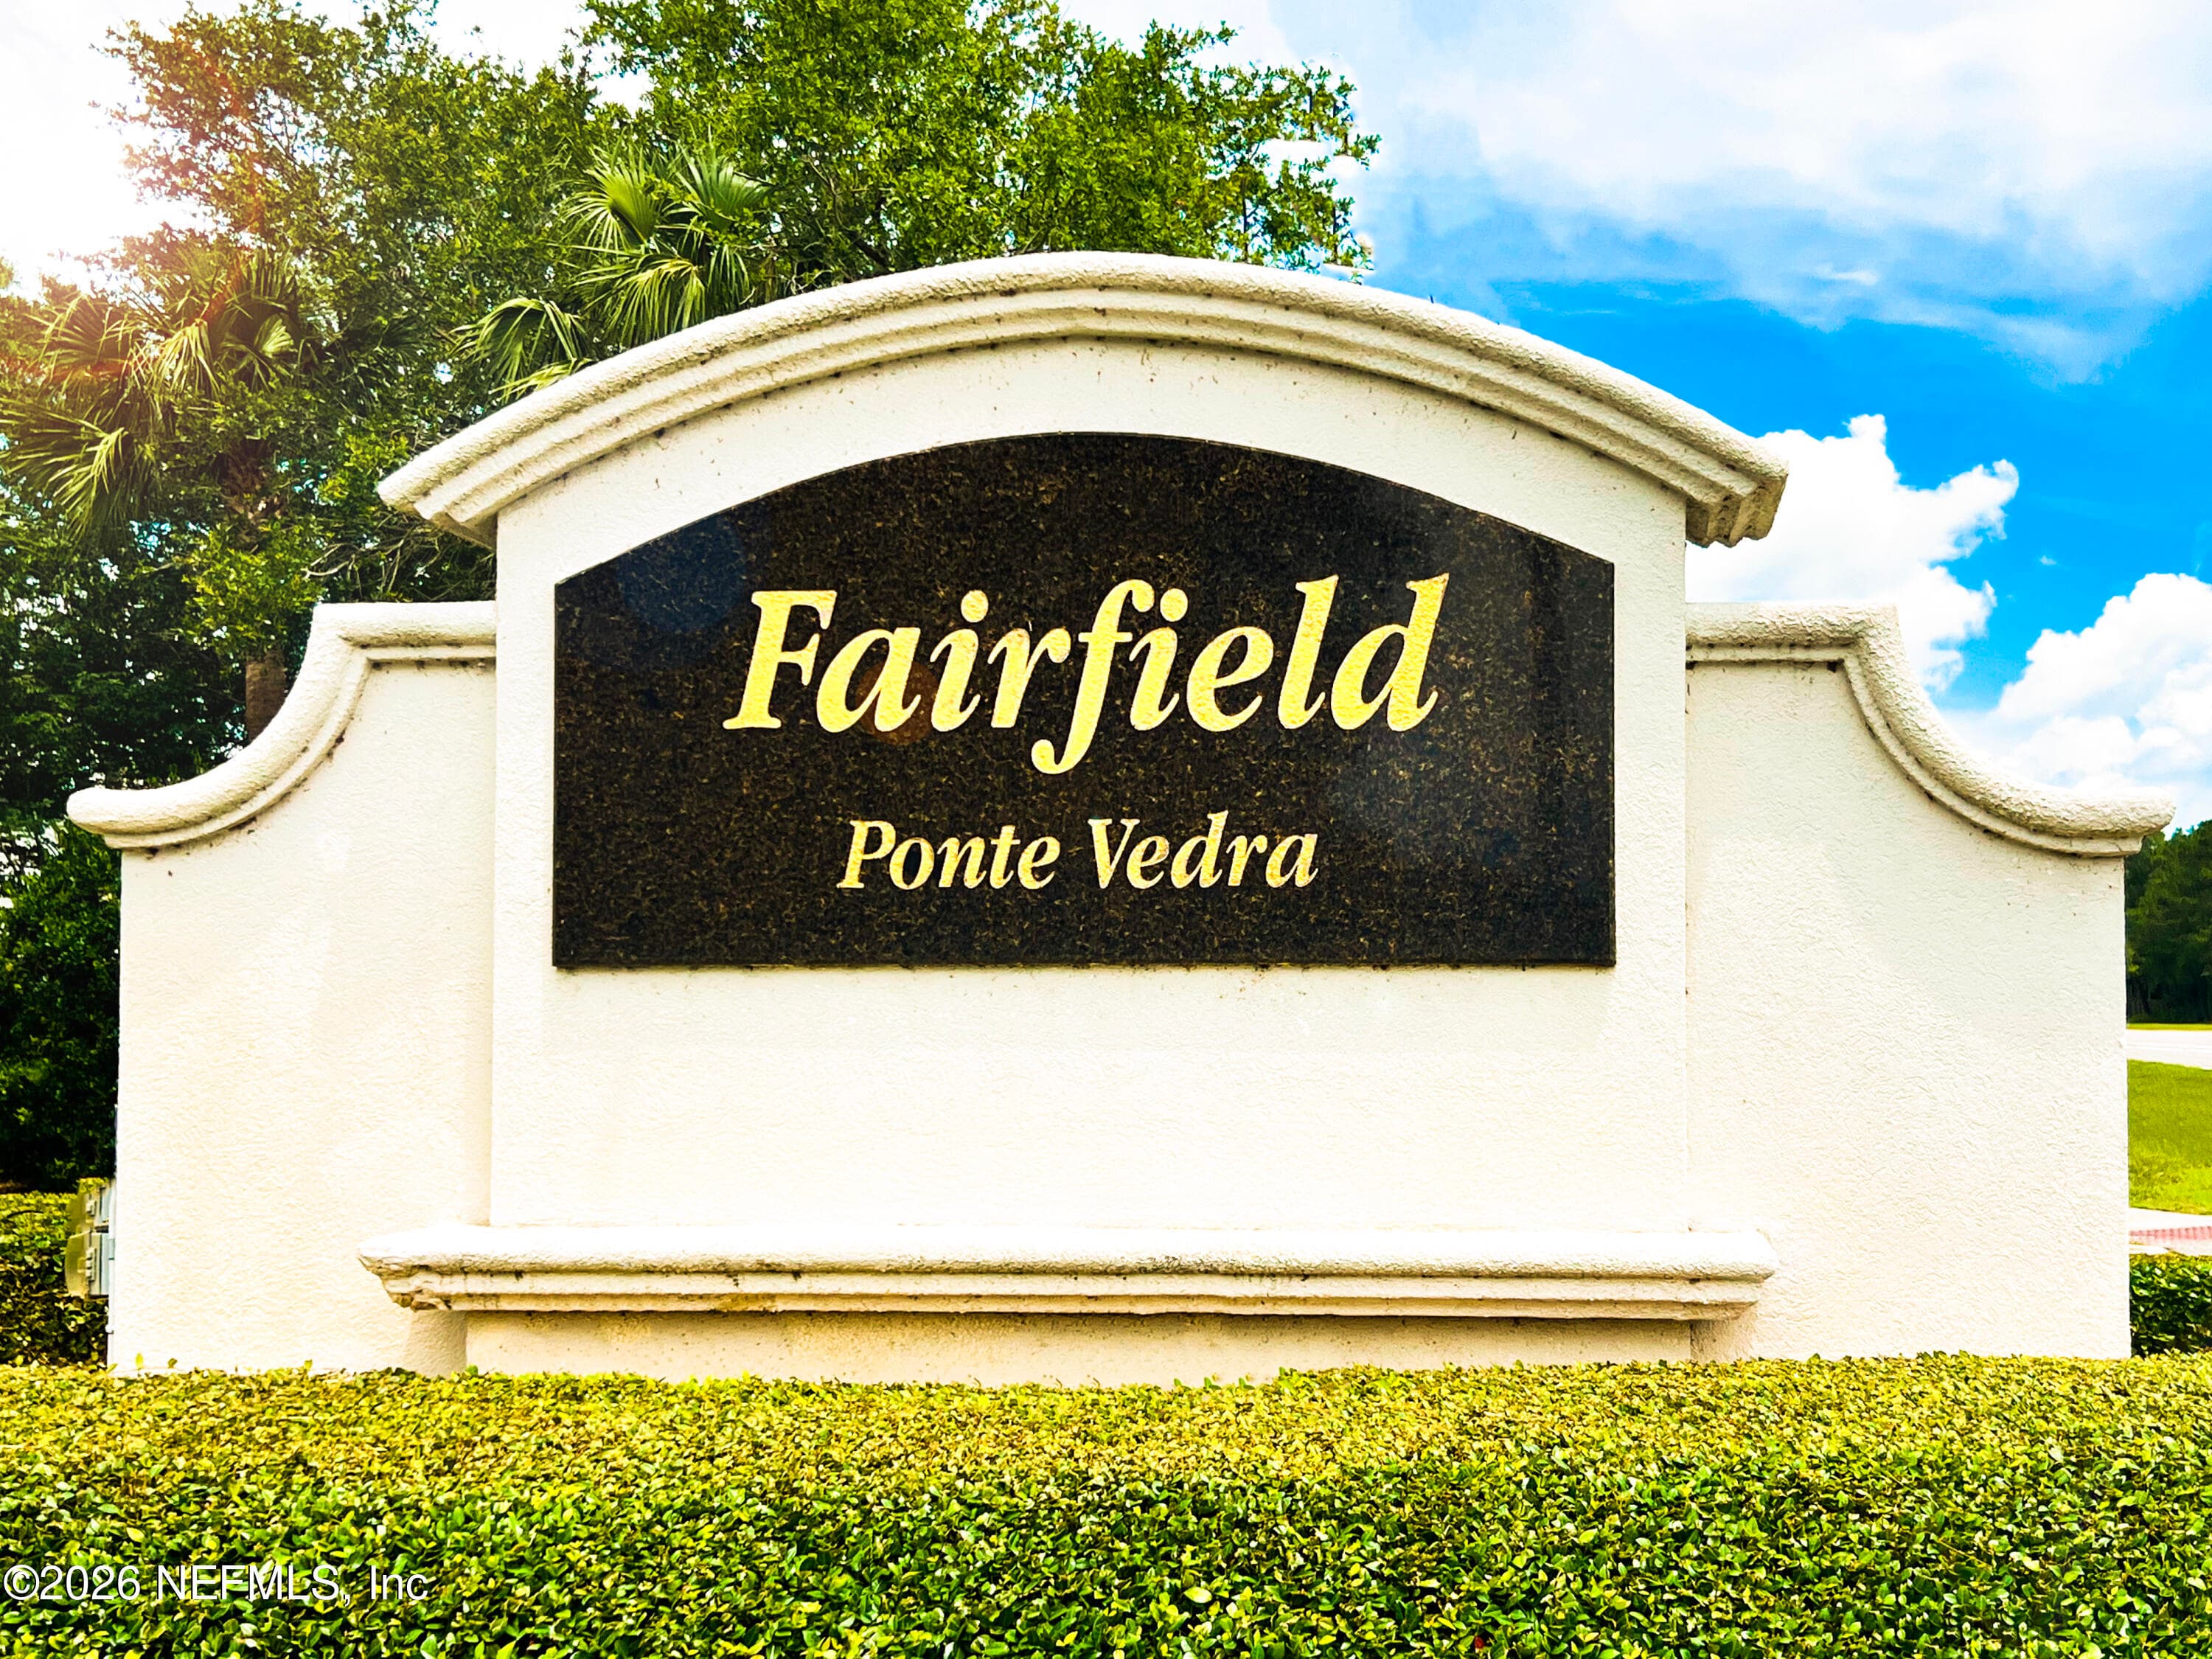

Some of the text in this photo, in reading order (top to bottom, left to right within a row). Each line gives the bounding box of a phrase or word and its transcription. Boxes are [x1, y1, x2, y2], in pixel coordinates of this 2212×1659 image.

[723, 573, 1449, 774] Fairfield
[836, 810, 1318, 889] Ponte Vedra
